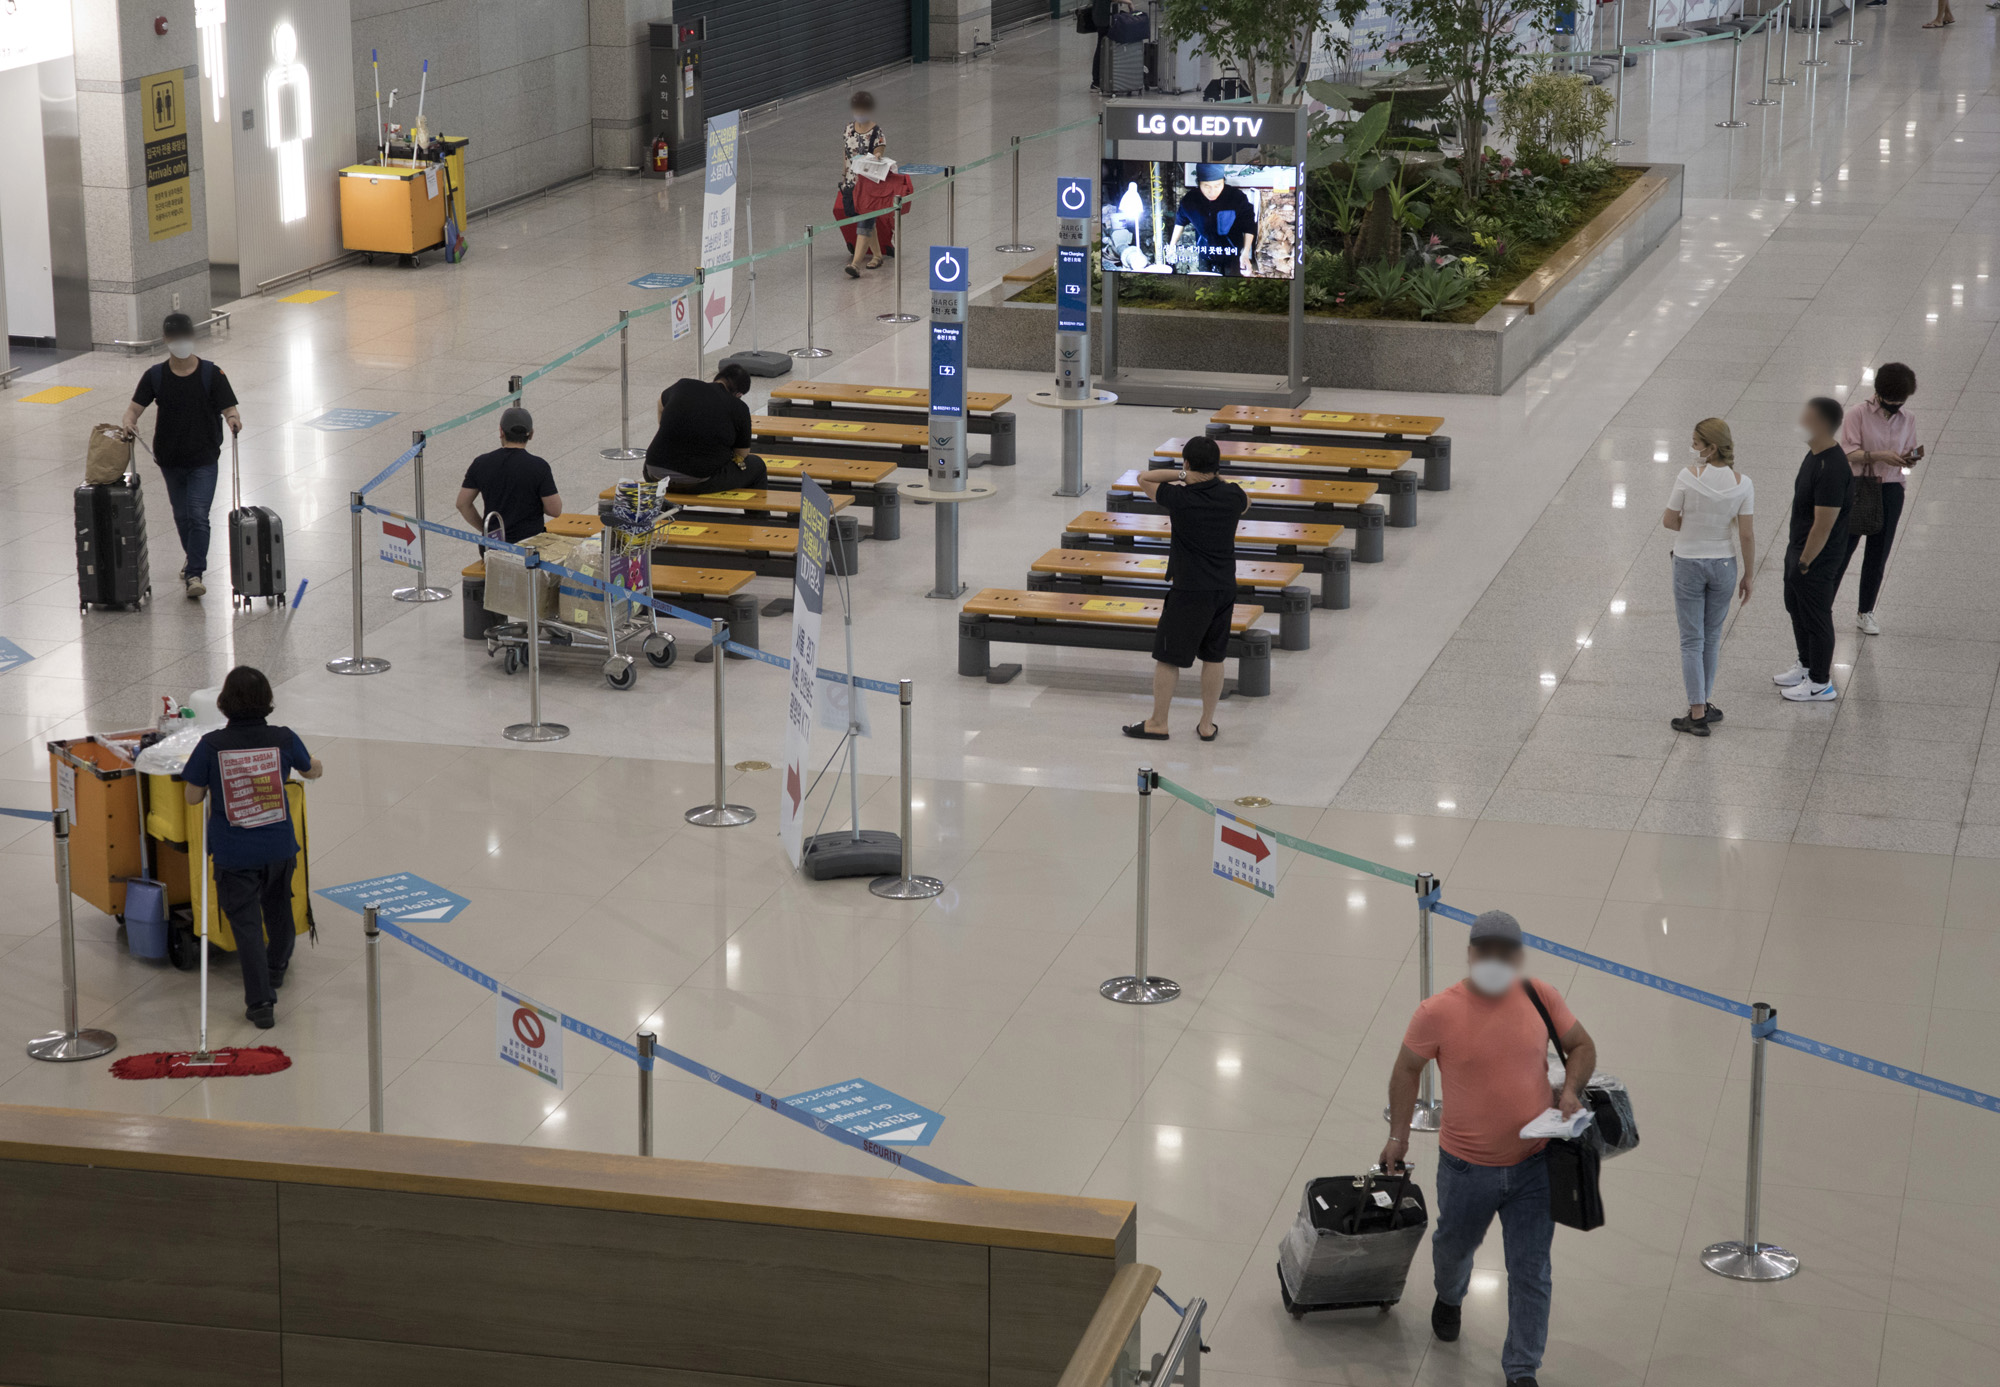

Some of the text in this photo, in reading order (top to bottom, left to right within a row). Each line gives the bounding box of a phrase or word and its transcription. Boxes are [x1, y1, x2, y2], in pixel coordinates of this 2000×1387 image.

[1137, 114, 1263, 138] LG OLED TV
[148, 160, 187, 181] Arrivals only
[1298, 161, 1305, 186] LG
[1297, 239, 1304, 265] TV
[931, 298, 958, 306] CHARGE
[802, 495, 828, 543] 해외입국자
[802, 525, 823, 568] 전용버스
[800, 552, 821, 596] 대기장소
[379, 897, 450, 916] 직진하세요
[826, 1103, 893, 1124] Go straight
[863, 1139, 902, 1165] SECURITY
